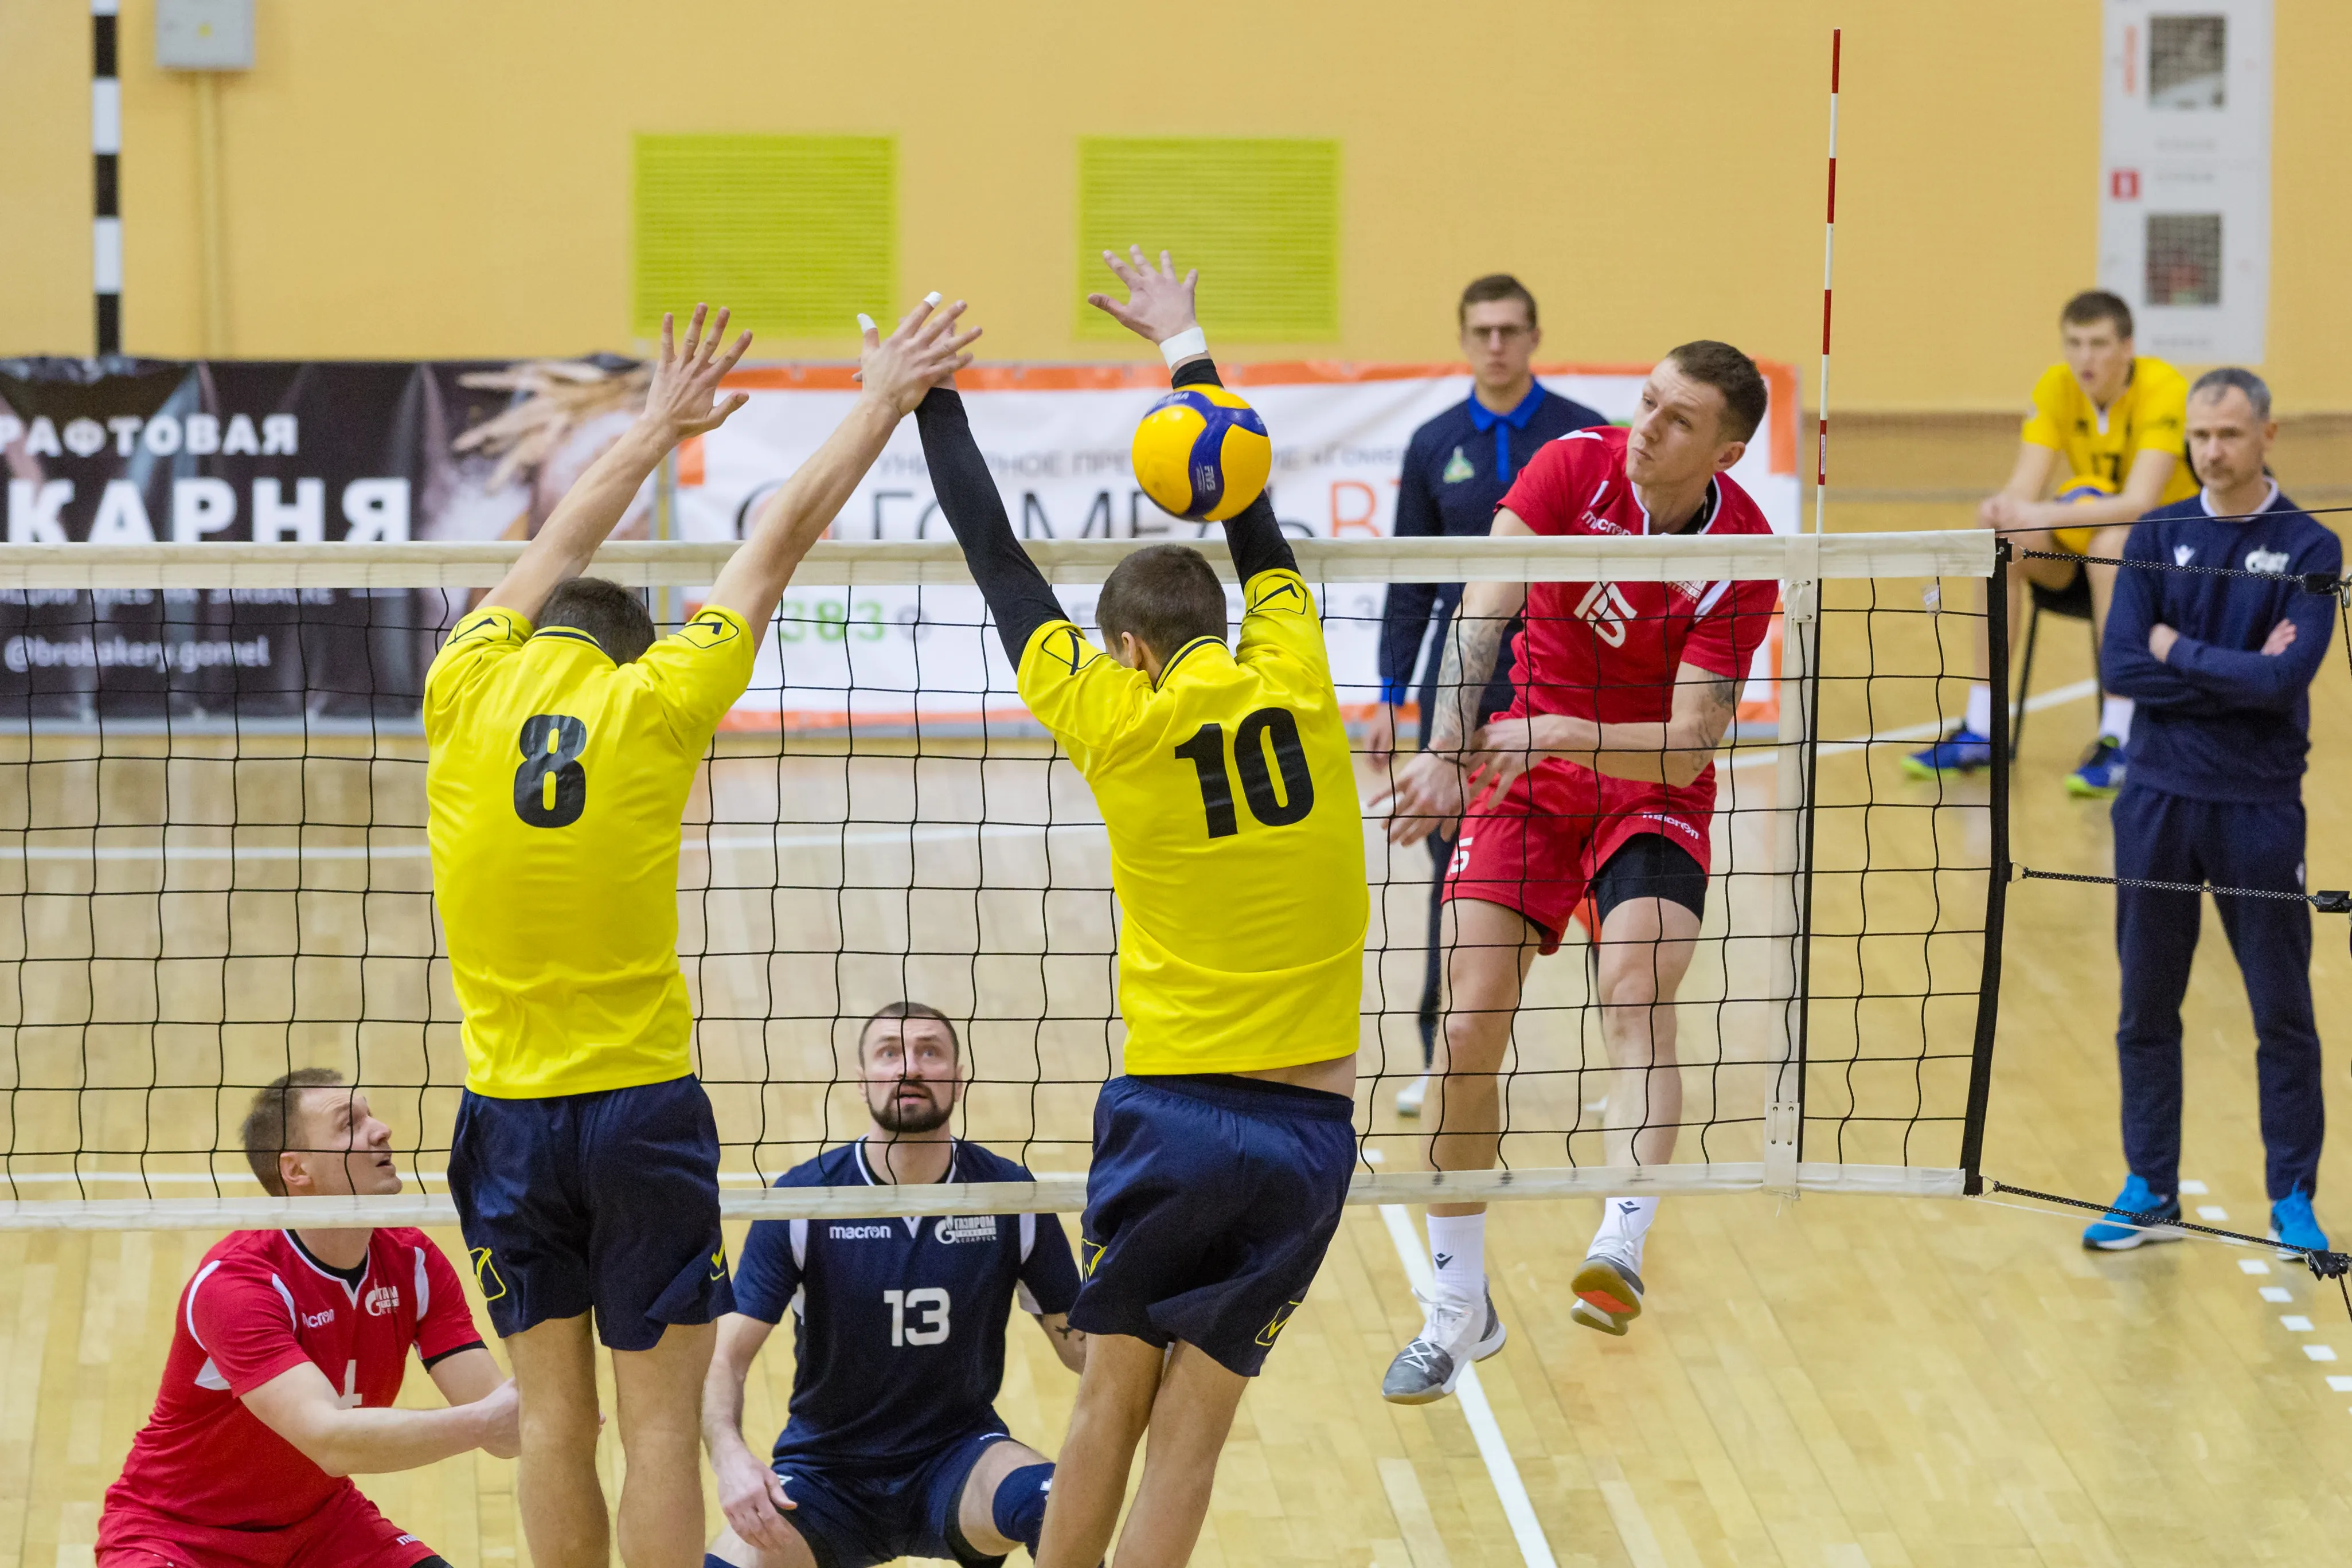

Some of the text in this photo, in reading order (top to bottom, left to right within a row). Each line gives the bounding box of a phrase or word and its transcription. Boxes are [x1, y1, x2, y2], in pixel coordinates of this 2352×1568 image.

[513, 714, 587, 828] 8
[1174, 706, 1314, 839] 10
[829, 1226, 892, 1239] macron
[884, 1287, 951, 1347] 13
